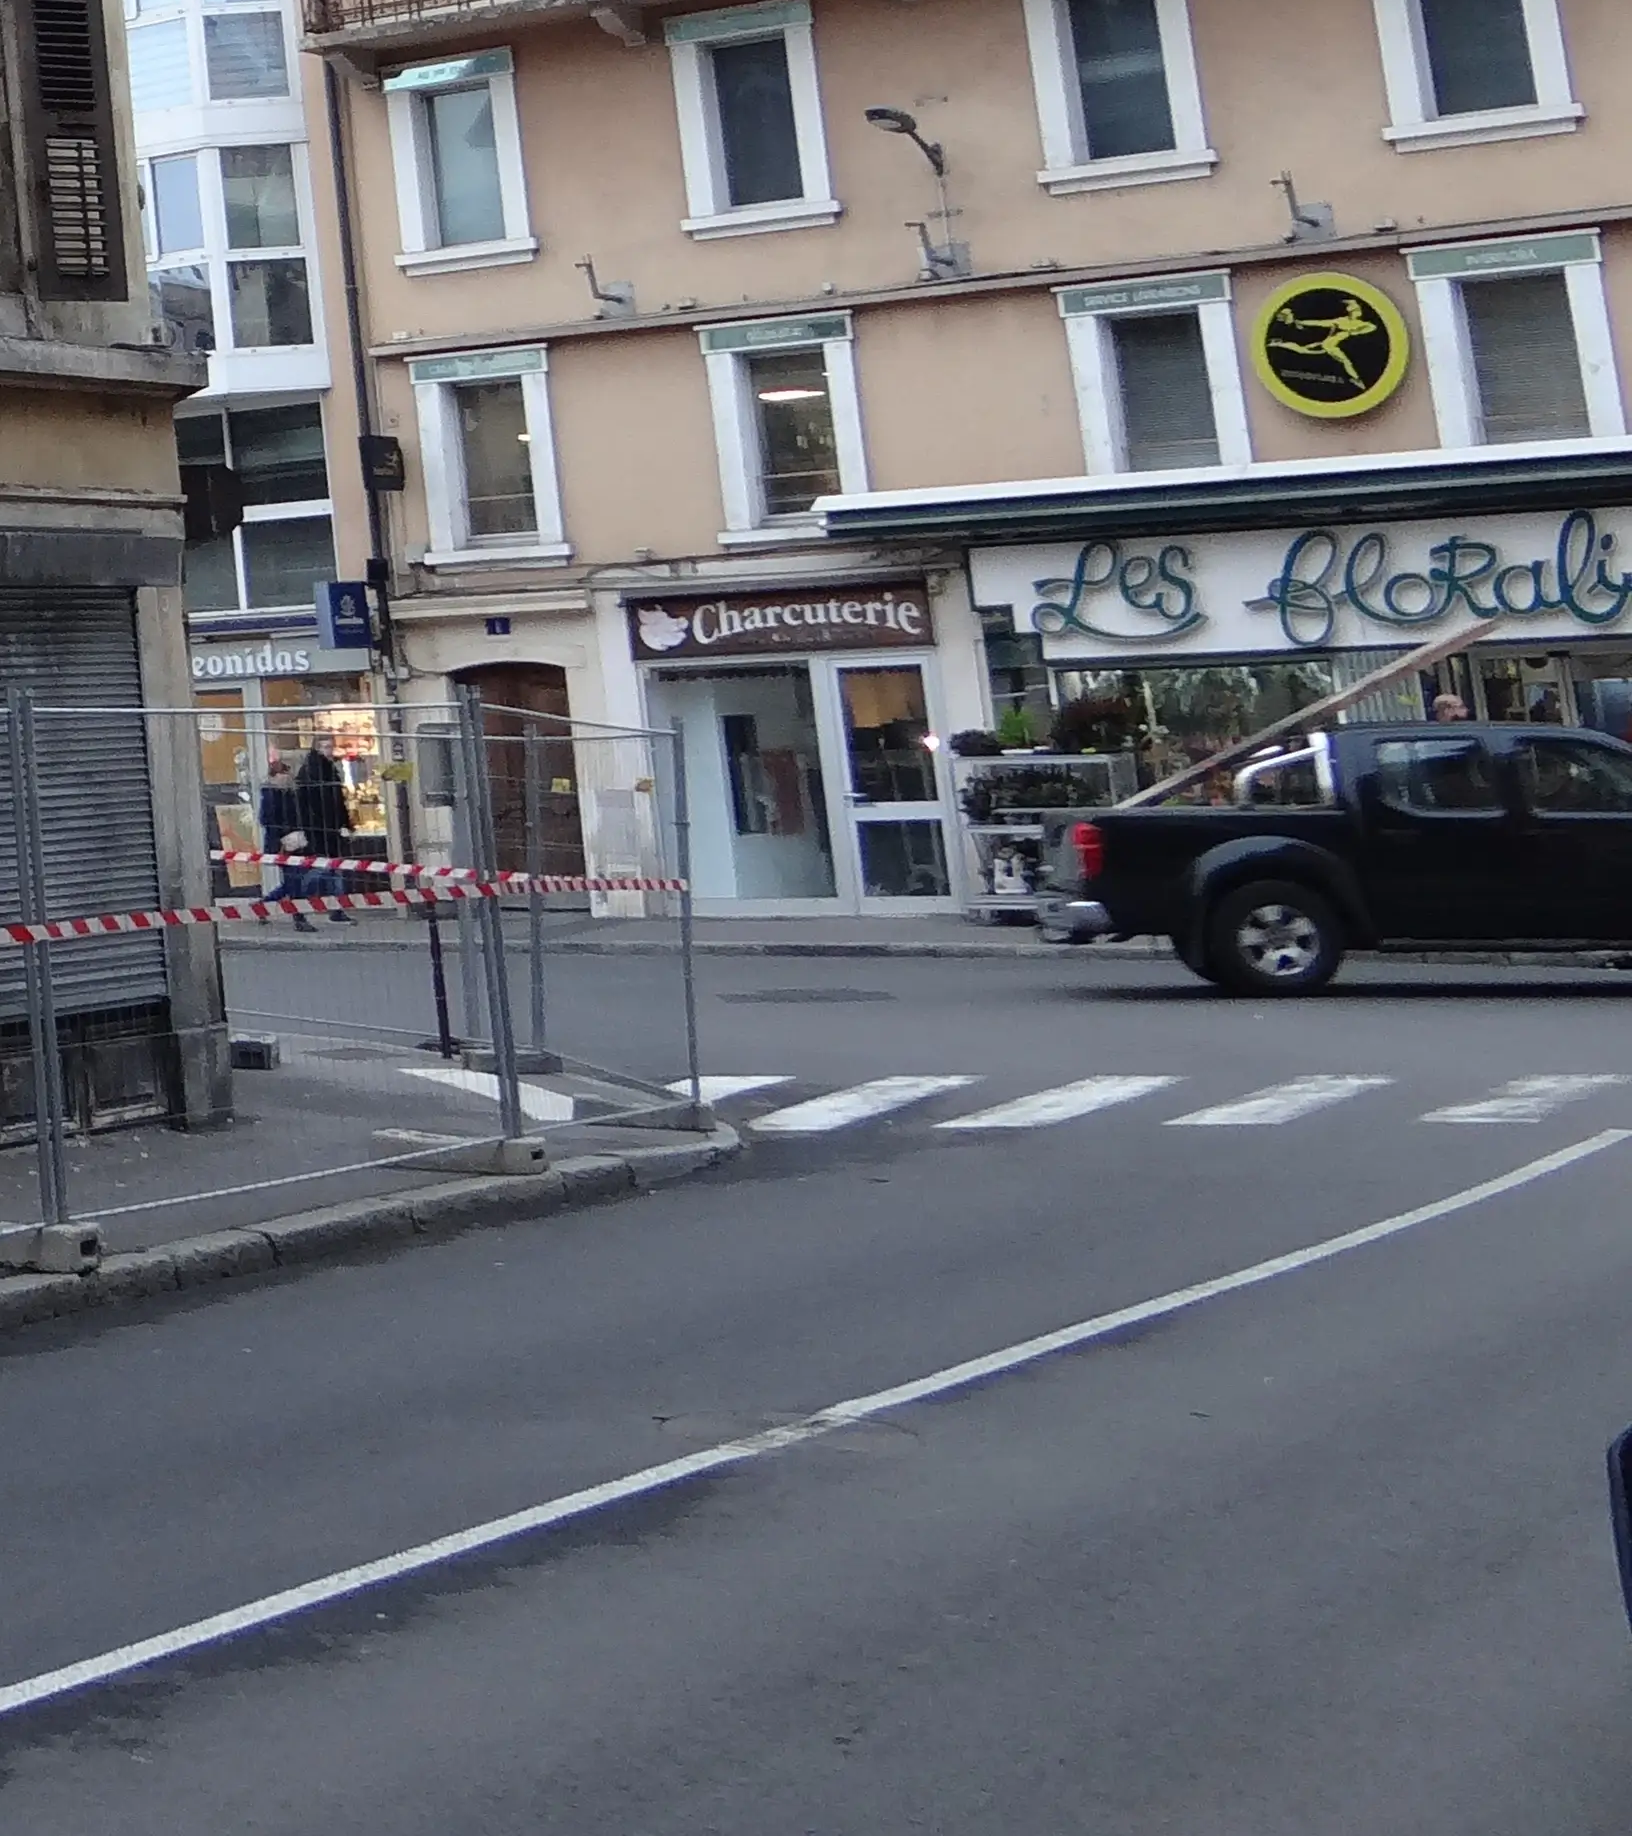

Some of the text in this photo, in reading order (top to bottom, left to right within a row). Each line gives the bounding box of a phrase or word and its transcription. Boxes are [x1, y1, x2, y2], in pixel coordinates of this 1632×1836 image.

[1031, 538, 1208, 643] Les
[692, 592, 924, 645] Charcuterie
[191, 643, 311, 677] eonidas
